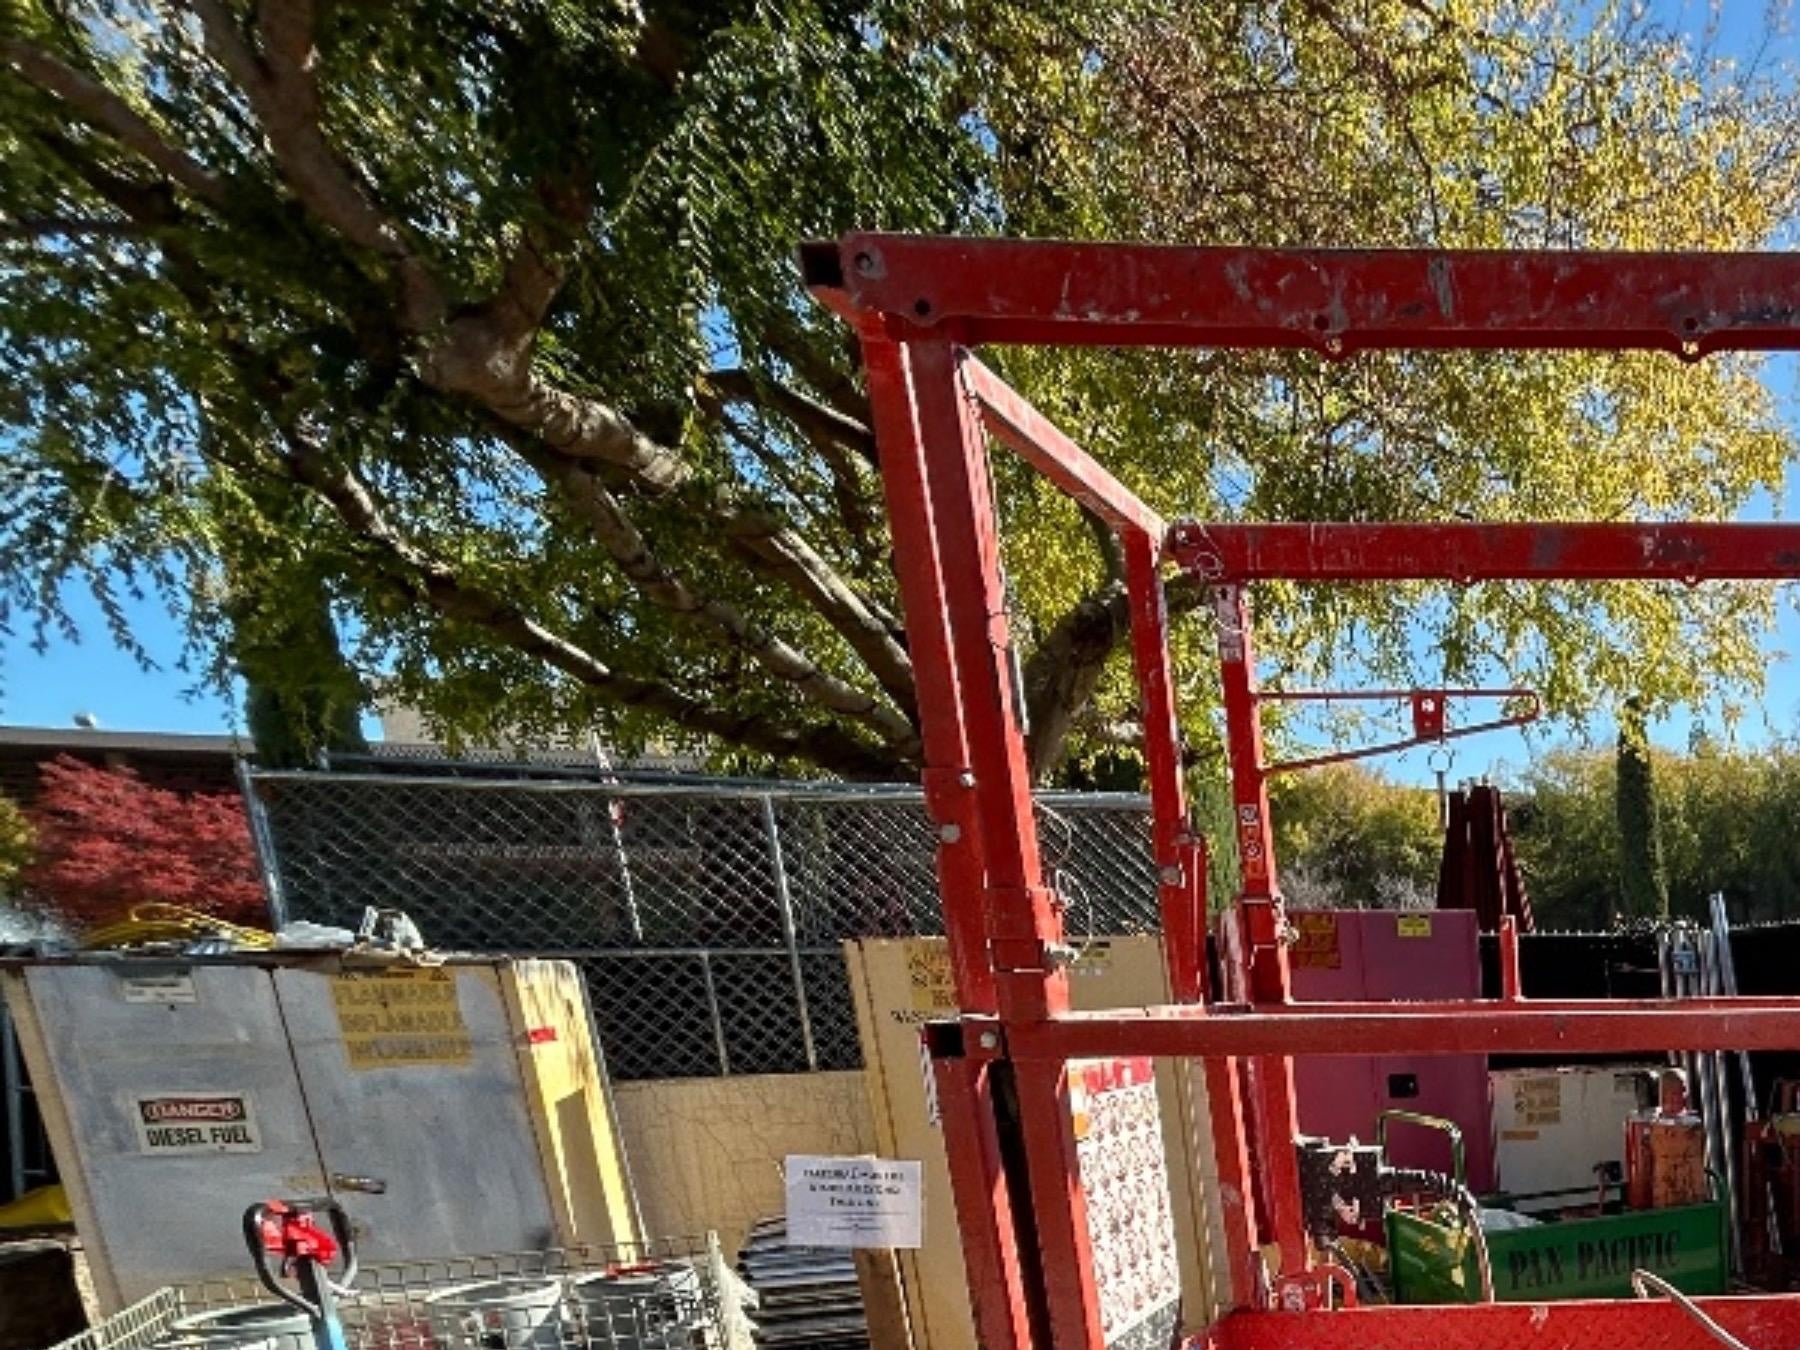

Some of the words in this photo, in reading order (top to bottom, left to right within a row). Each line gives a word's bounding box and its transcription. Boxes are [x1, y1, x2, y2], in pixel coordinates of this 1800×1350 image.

[146, 1127, 207, 1147] DIESEL
[210, 1124, 253, 1143] FUEL
[1508, 1247, 1565, 1290] PAN
[1577, 1230, 1682, 1281] PACIFIC
